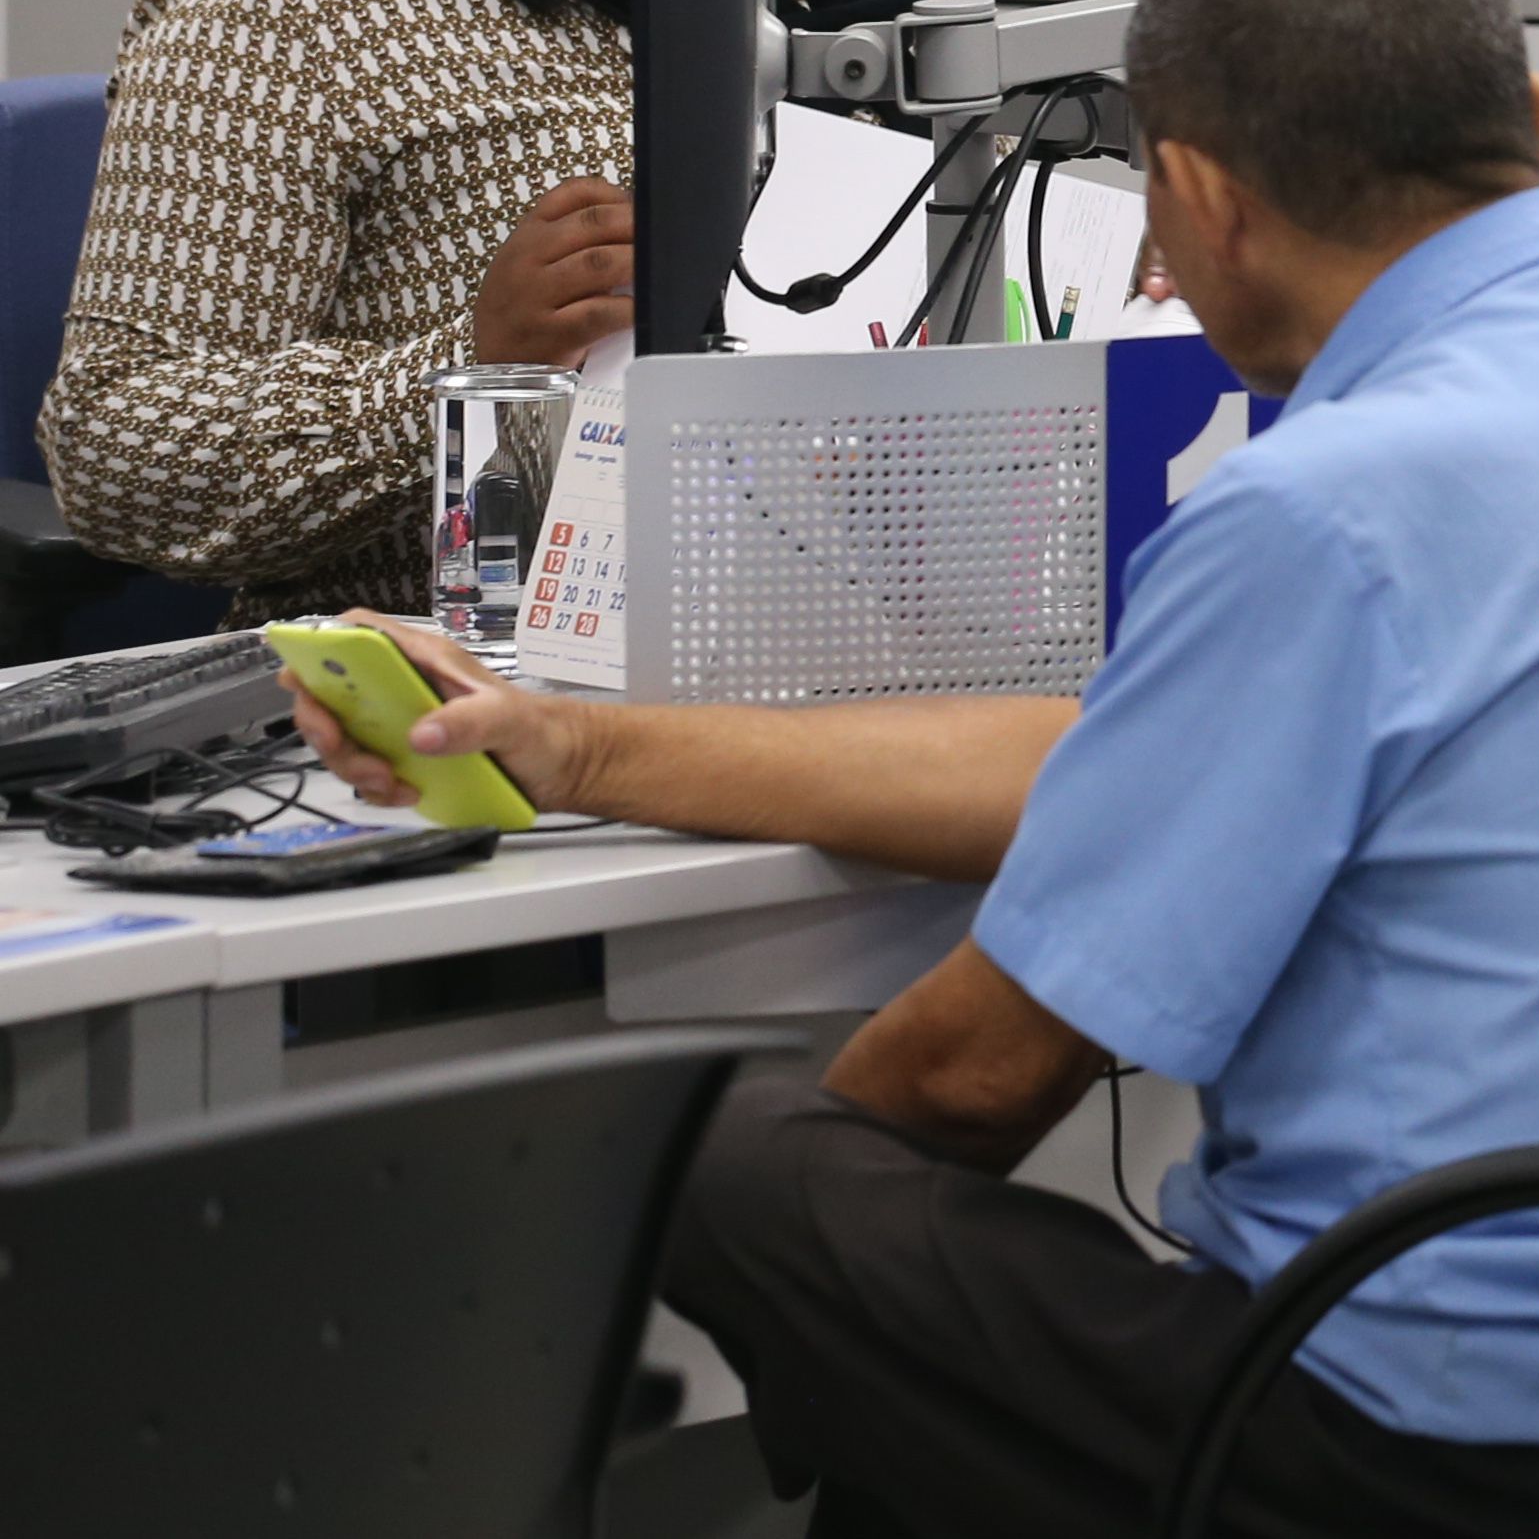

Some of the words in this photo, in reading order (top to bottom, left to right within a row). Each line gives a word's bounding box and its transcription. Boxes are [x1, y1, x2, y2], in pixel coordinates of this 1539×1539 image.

[580, 421, 626, 447] CAIXA
[556, 525, 569, 544] 5
[580, 530, 590, 548] 6
[603, 534, 614, 550] 7
[547, 552, 565, 572] 12
[570, 557, 586, 576] 13
[594, 561, 610, 579] 14
[539, 580, 557, 599] 19
[562, 585, 579, 604] 20
[586, 588, 602, 607] 21
[609, 592, 626, 611] 22
[530, 607, 549, 627] 26
[555, 612, 572, 630] 27
[577, 614, 596, 635] 28
